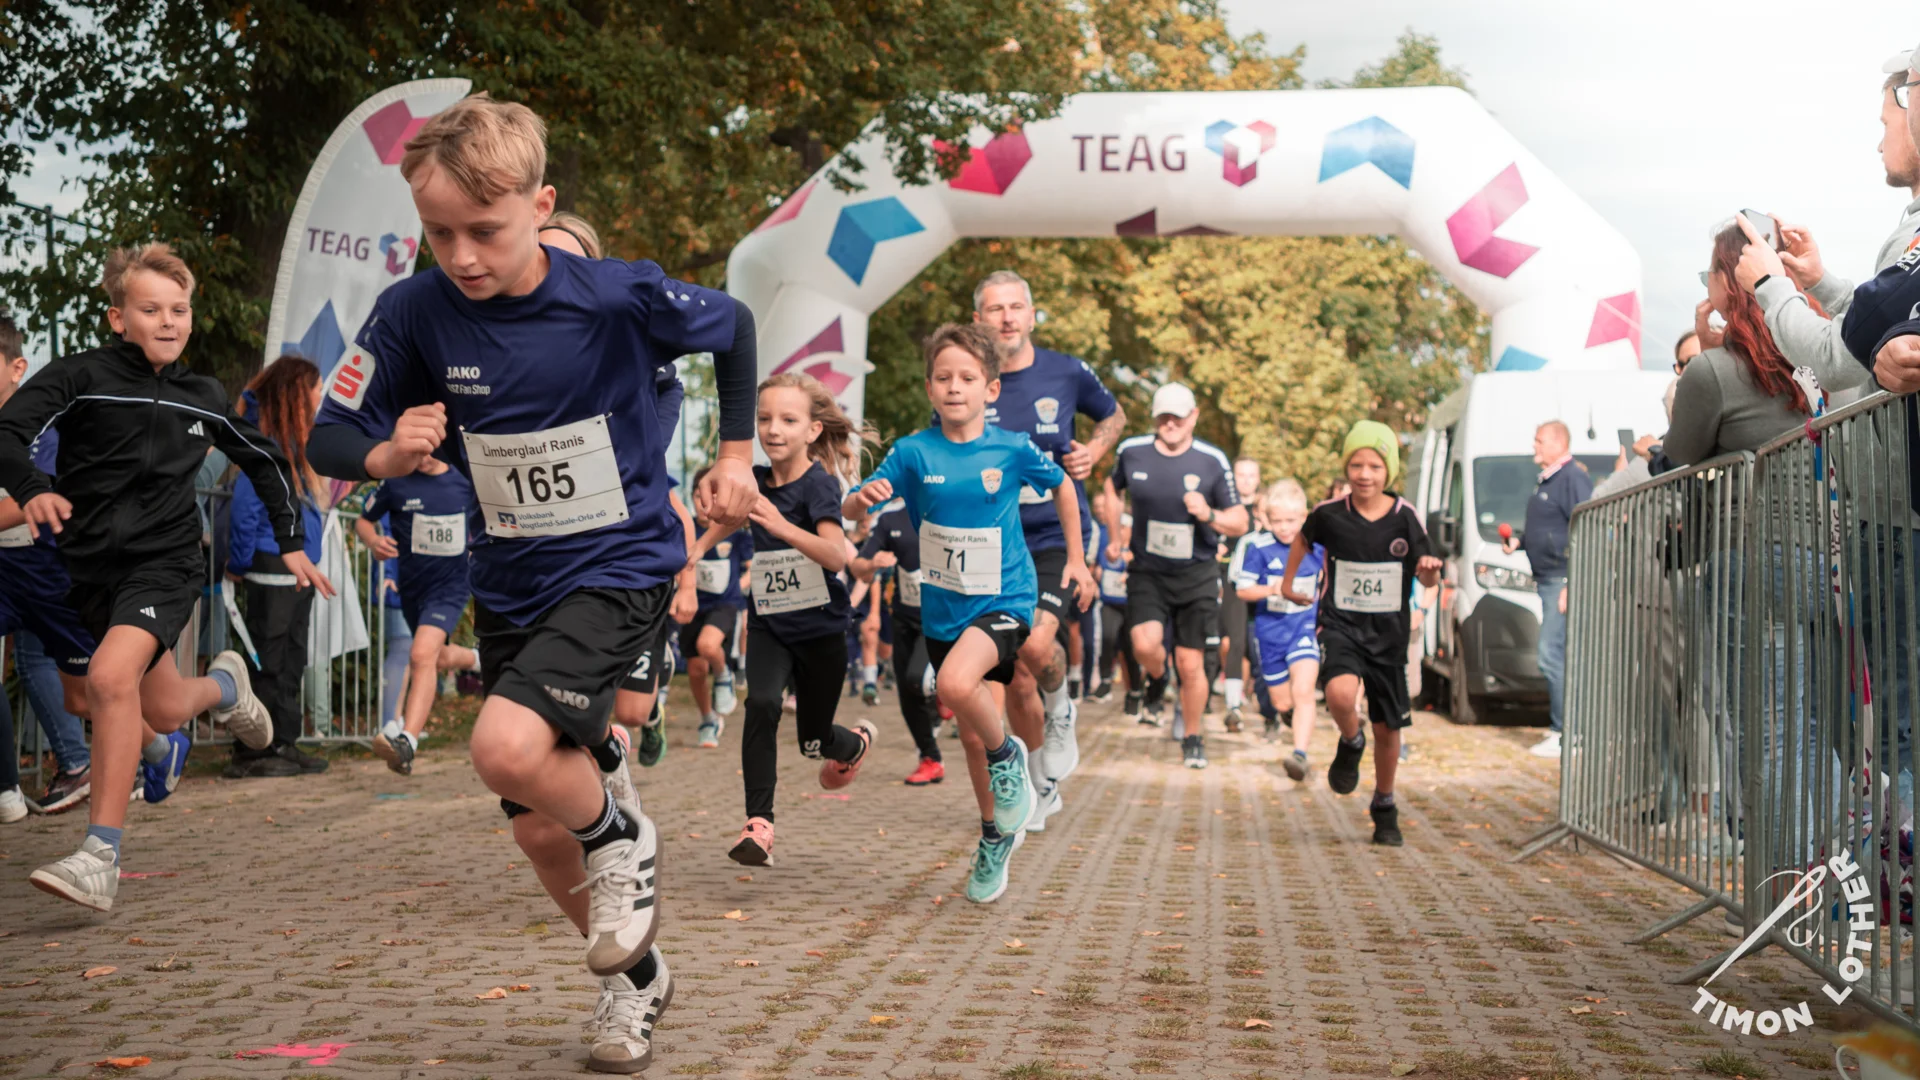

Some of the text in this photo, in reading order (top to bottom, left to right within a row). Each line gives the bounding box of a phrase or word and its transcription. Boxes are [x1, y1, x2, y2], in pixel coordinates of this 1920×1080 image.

[1071, 134, 1186, 172] TEAG
[308, 228, 371, 261] TEAG
[446, 366, 481, 379] JAKO
[460, 384, 472, 395] Fan
[472, 384, 491, 396] Shop
[482, 435, 585, 459] Limberglauf Ranis
[506, 461, 576, 504] 165
[923, 475, 946, 484] JAKO
[517, 511, 555, 521] Volksbank
[519, 509, 607, 530] Vogtland-Saale-Orla eG
[428, 528, 453, 543] 188
[943, 547, 966, 573] 71
[764, 568, 802, 594] 254
[1353, 578, 1383, 597] 264
[631, 655, 651, 680] 2
